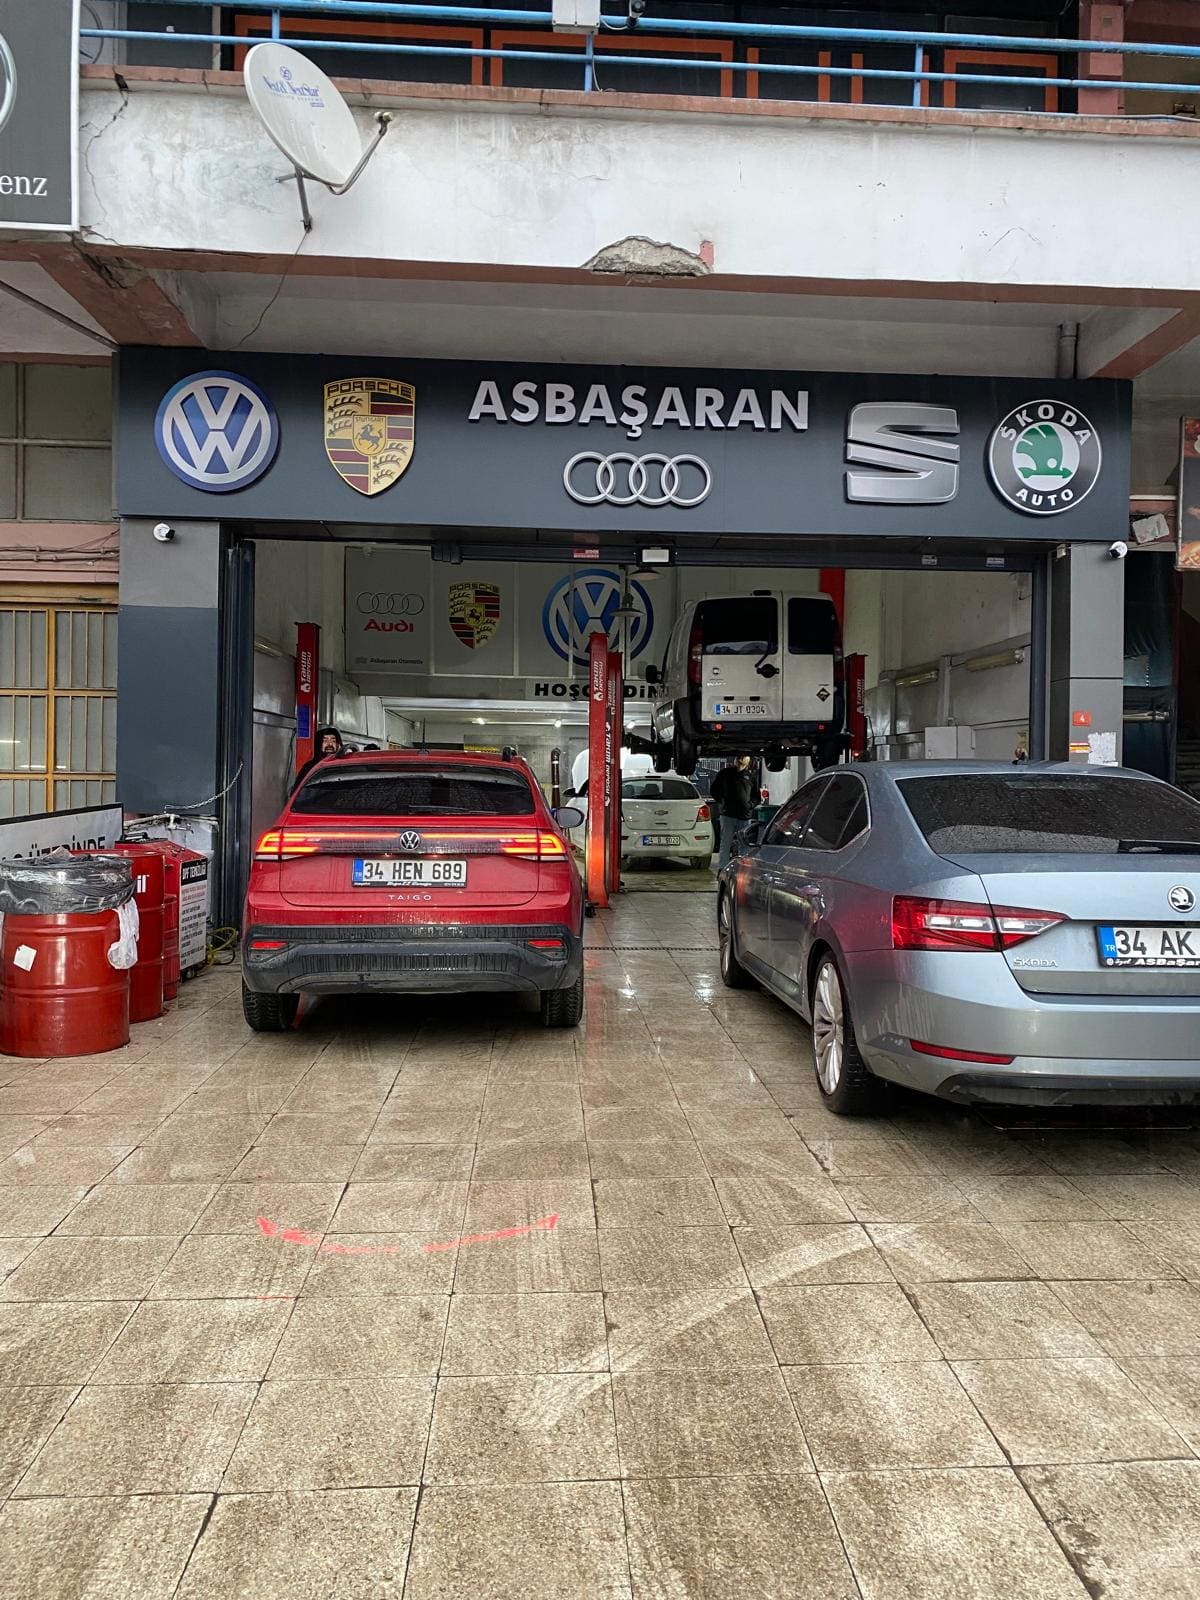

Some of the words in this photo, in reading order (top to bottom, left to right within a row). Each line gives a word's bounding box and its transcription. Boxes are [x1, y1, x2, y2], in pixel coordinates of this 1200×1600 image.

[327, 380, 412, 399] PORSCHE
[468, 380, 810, 438] ASBAŞARAN
[1000, 404, 1092, 446] ŠKODA
[1016, 488, 1074, 506] AUTO
[449, 583, 499, 593] PORSCHE
[364, 619, 414, 632] Audi
[721, 705, 731, 714] 34
[364, 863, 384, 880] 34
[392, 863, 423, 880] HEN
[432, 864, 463, 880] 689
[1105, 944, 1116, 952] TR
[1115, 930, 1147, 955] 34
[1160, 931, 1197, 956] AK
